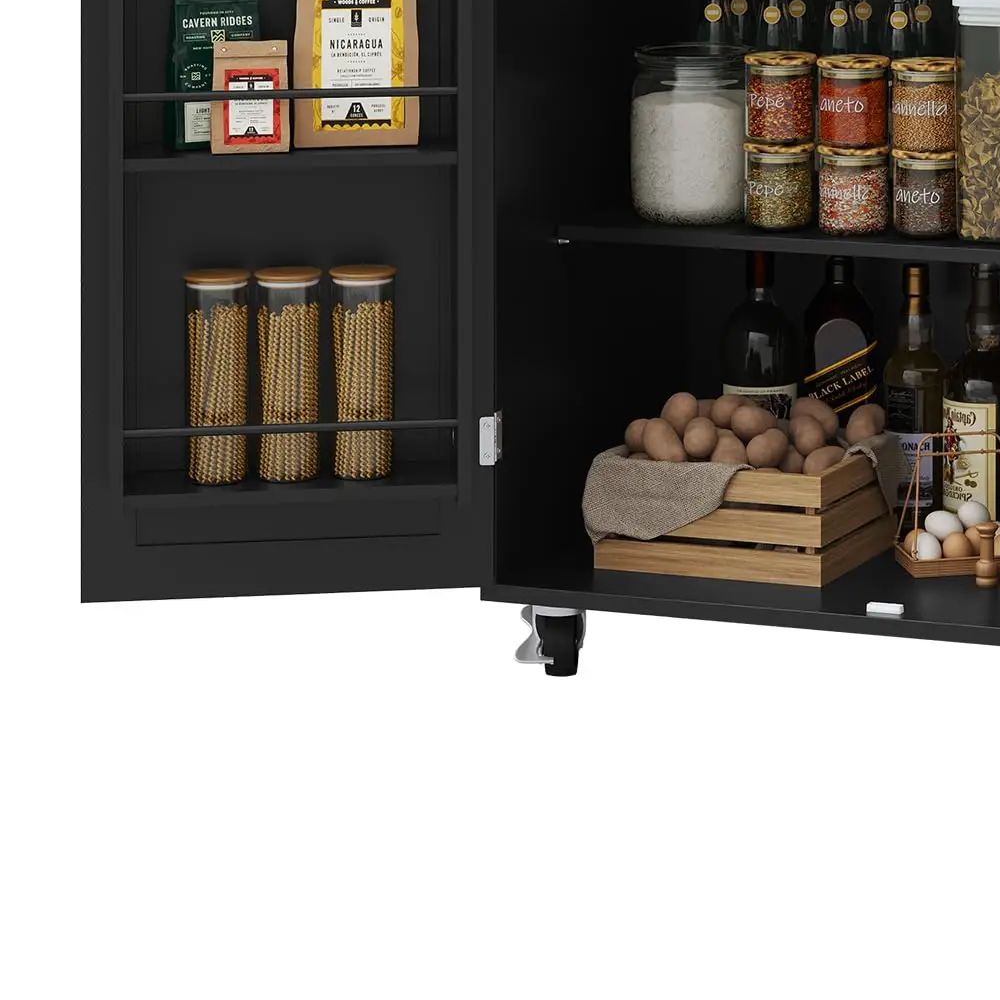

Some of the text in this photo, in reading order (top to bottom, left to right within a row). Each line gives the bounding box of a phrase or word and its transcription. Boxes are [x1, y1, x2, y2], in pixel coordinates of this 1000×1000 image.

[182, 15, 253, 28] CAVERN RIDGES
[329, 39, 384, 50] NICARAGUA
[352, 104, 361, 113] 12
[749, 93, 785, 112] Pepe
[820, 97, 865, 113] aneto
[749, 181, 785, 197] Pepe
[895, 187, 941, 205] aneto
[841, 365, 874, 386] LABEL
